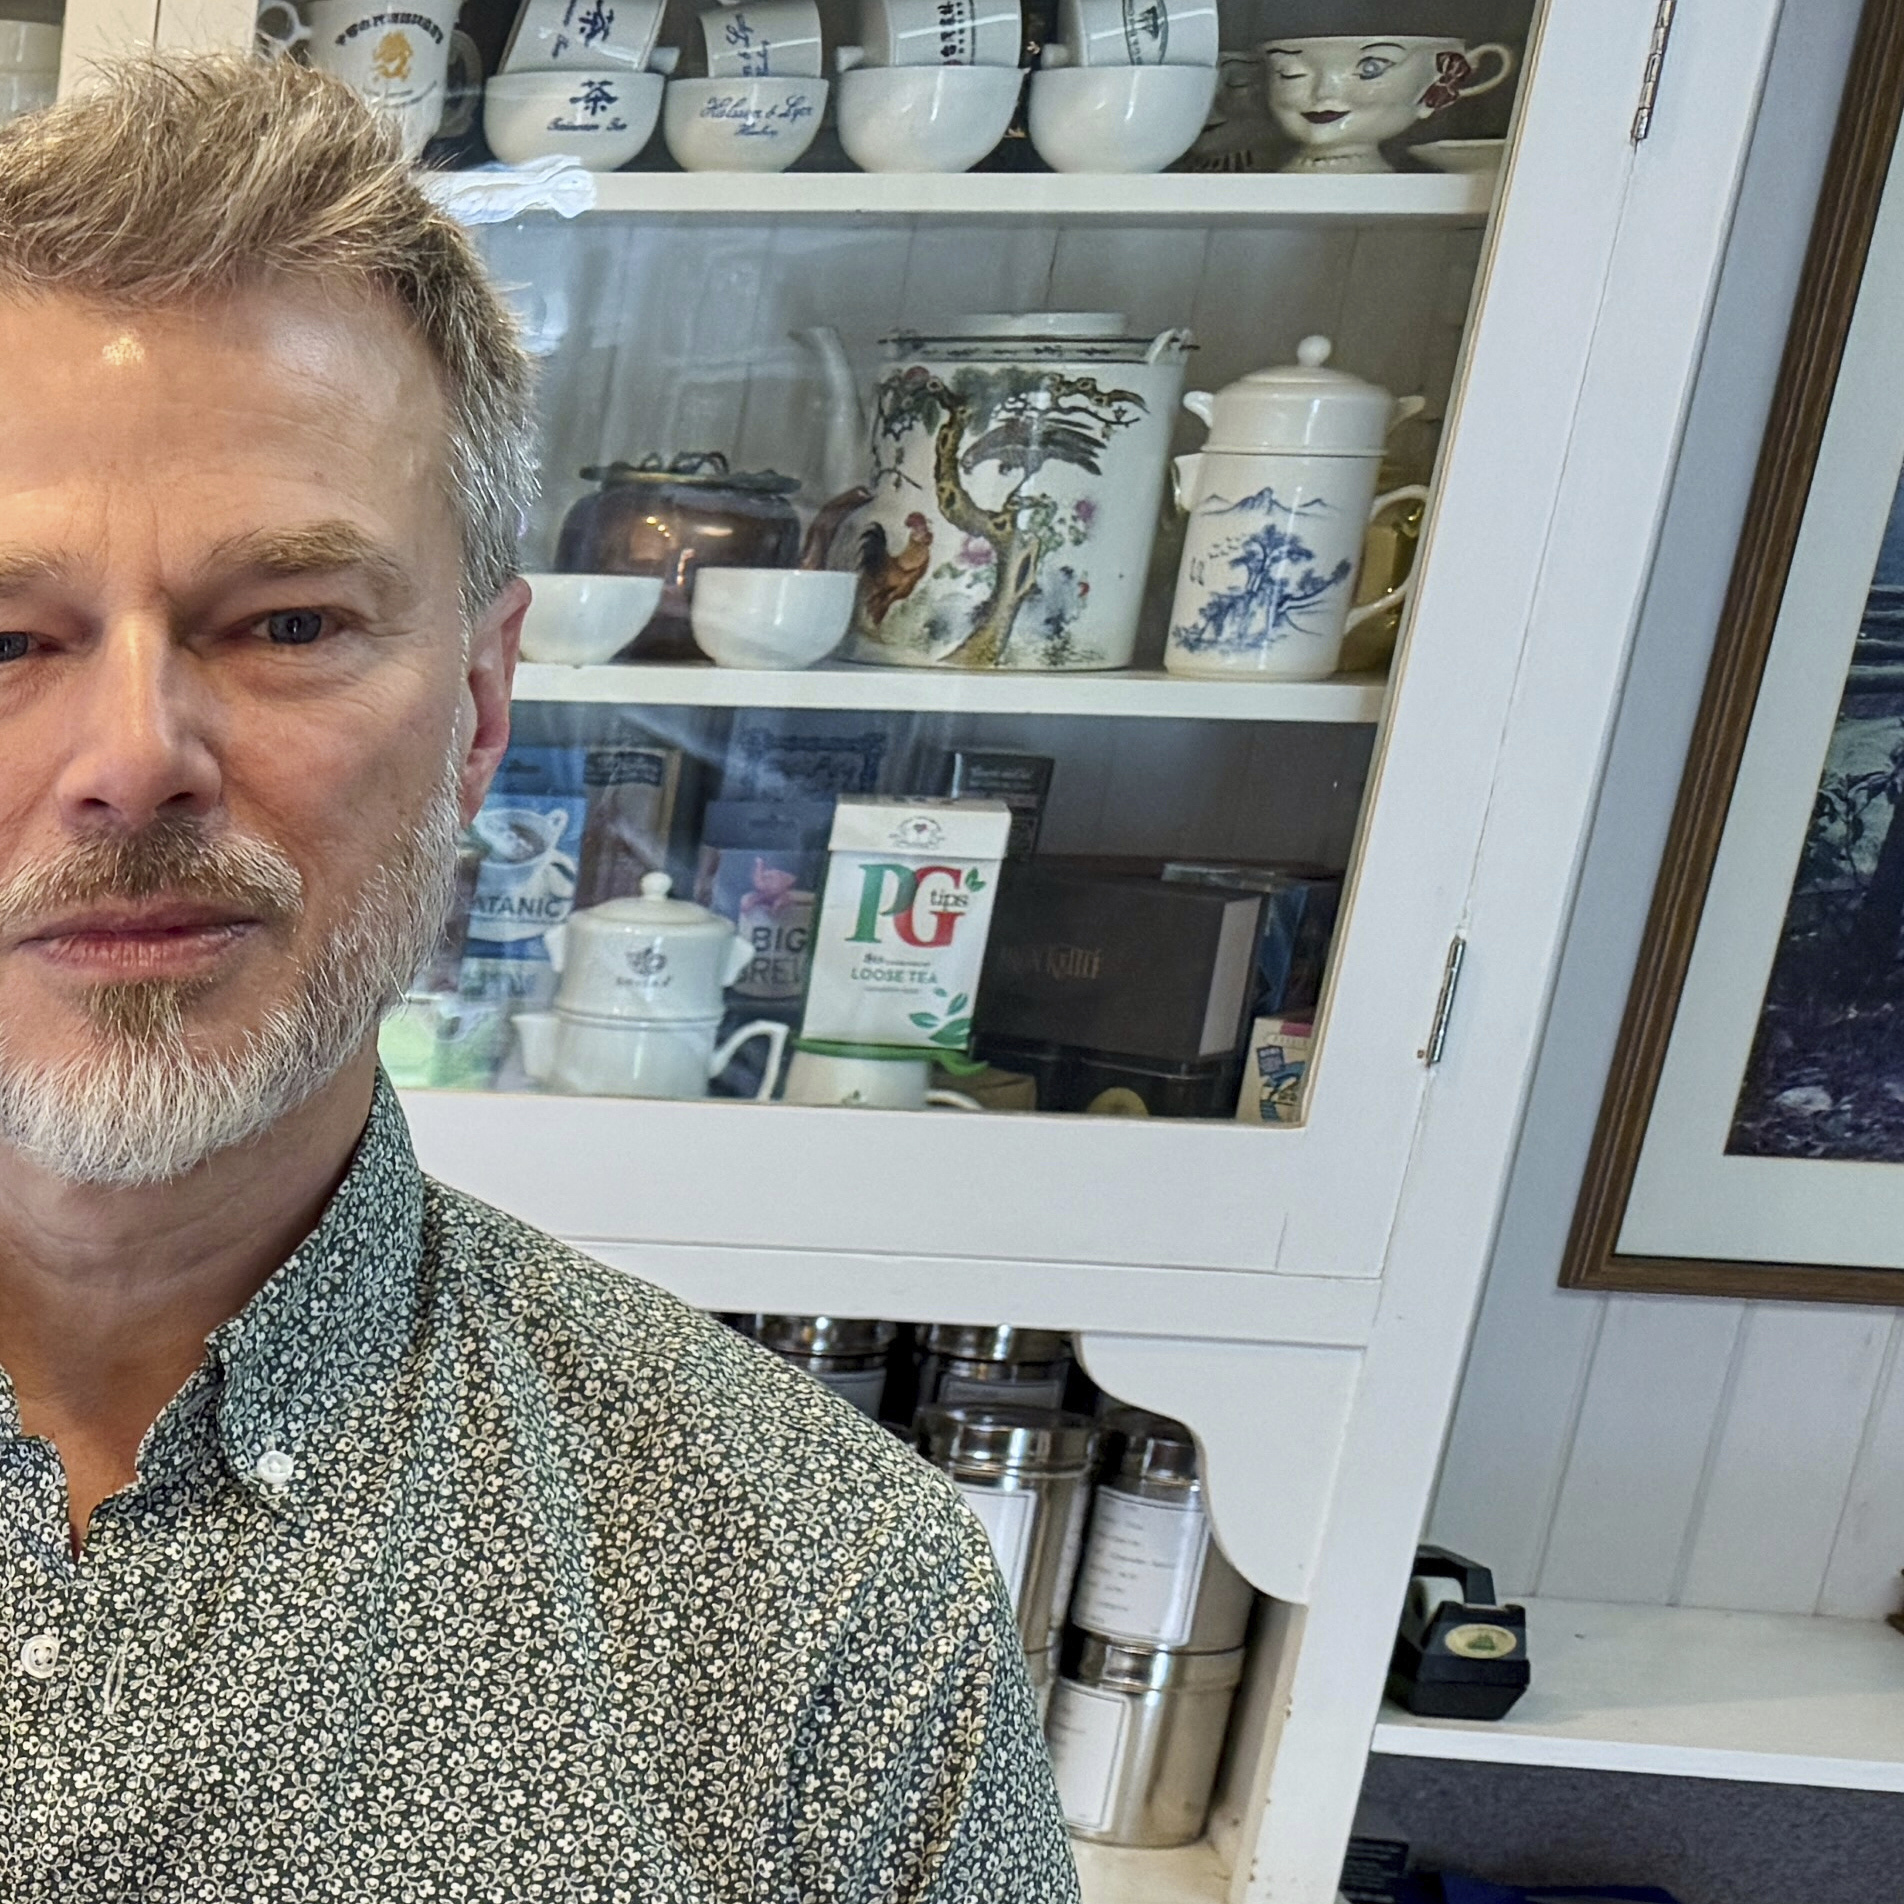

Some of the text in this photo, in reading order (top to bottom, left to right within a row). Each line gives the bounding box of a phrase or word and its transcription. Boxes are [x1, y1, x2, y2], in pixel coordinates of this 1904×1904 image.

[569, 80, 619, 115] 茶
[844, 863, 962, 948] PG
[929, 889, 970, 911] tips
[753, 926, 808, 954] BIG
[850, 967, 938, 984] LOOSE TEA
